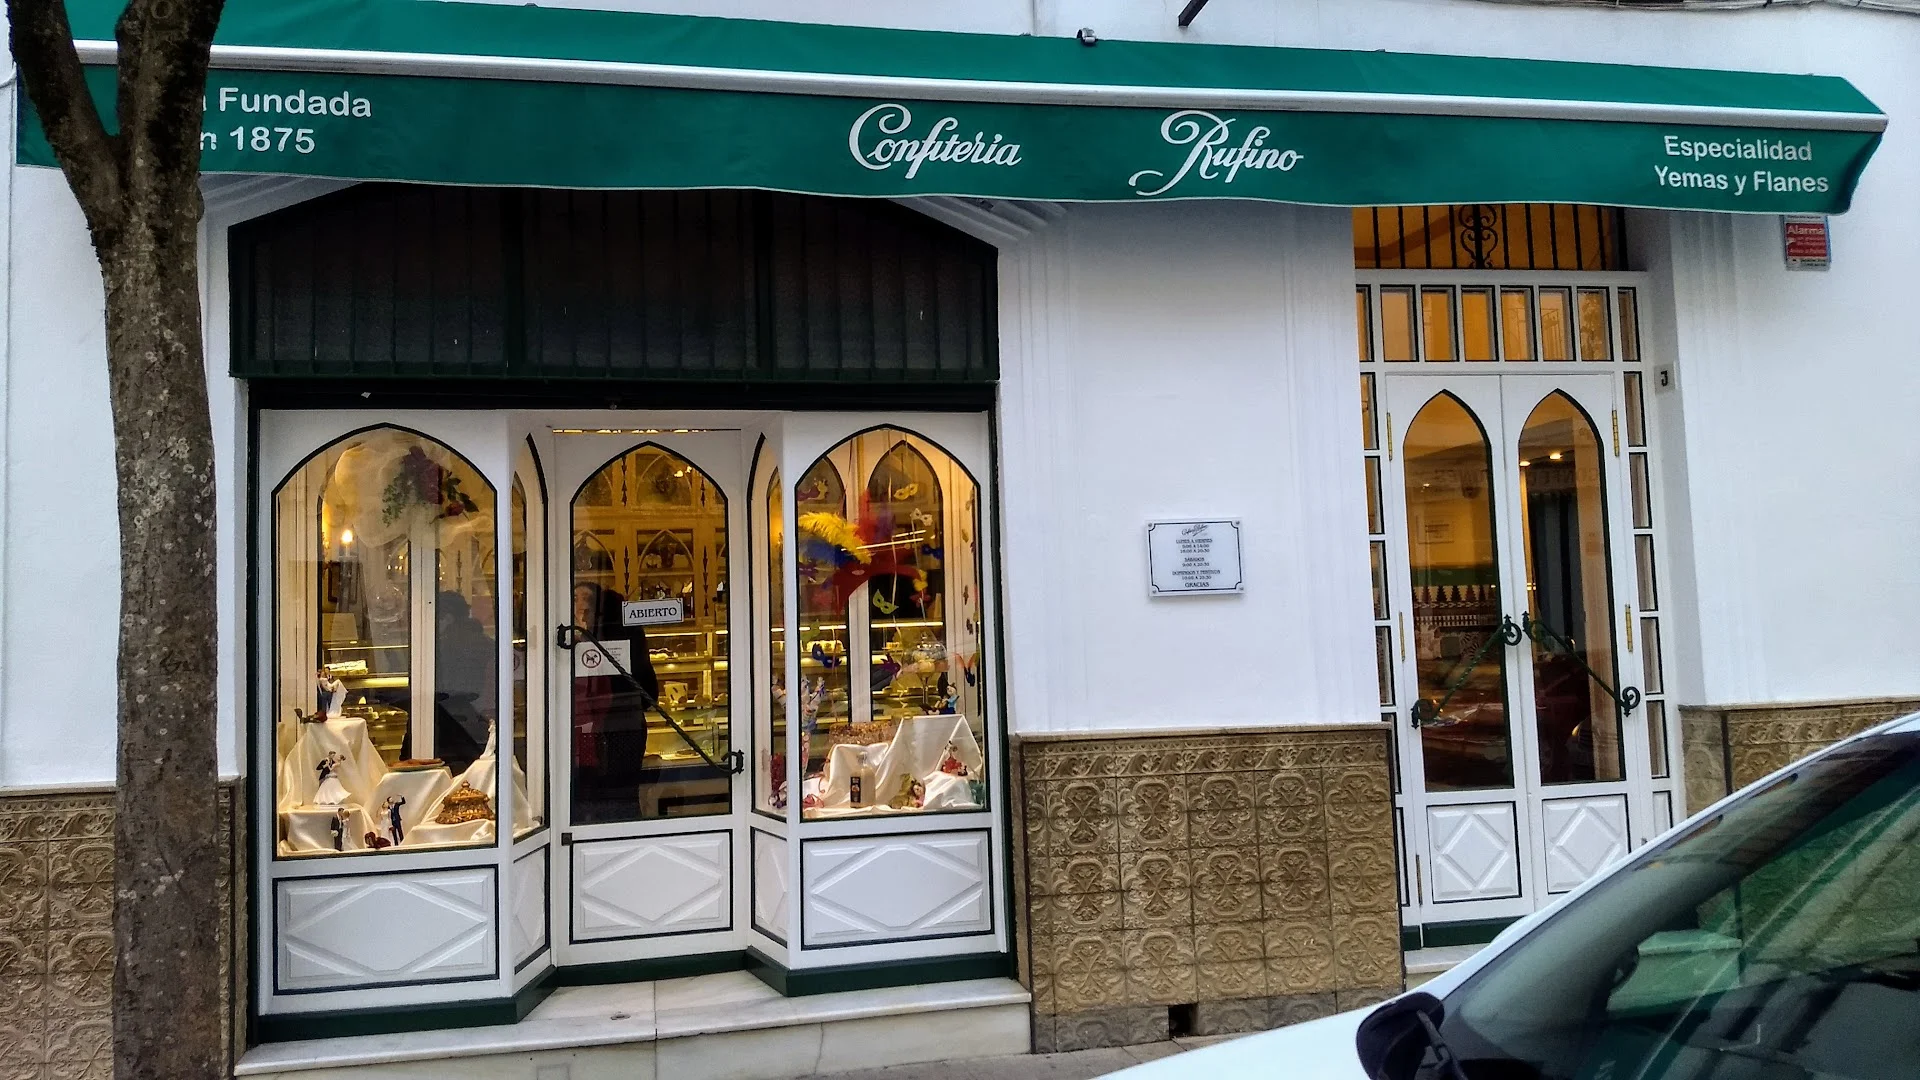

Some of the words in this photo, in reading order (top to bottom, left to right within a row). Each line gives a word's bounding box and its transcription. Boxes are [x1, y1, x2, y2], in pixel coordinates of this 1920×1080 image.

[219, 87, 372, 118] Fundada
[229, 125, 316, 154] 1875
[1128, 110, 1304, 196] Rufino
[1663, 135, 1813, 162] Especialidad
[1654, 164, 1729, 190] Yemas
[1734, 174, 1747, 196] y
[1753, 170, 1829, 193] Flanes
[629, 607, 678, 619] ABIERTO
